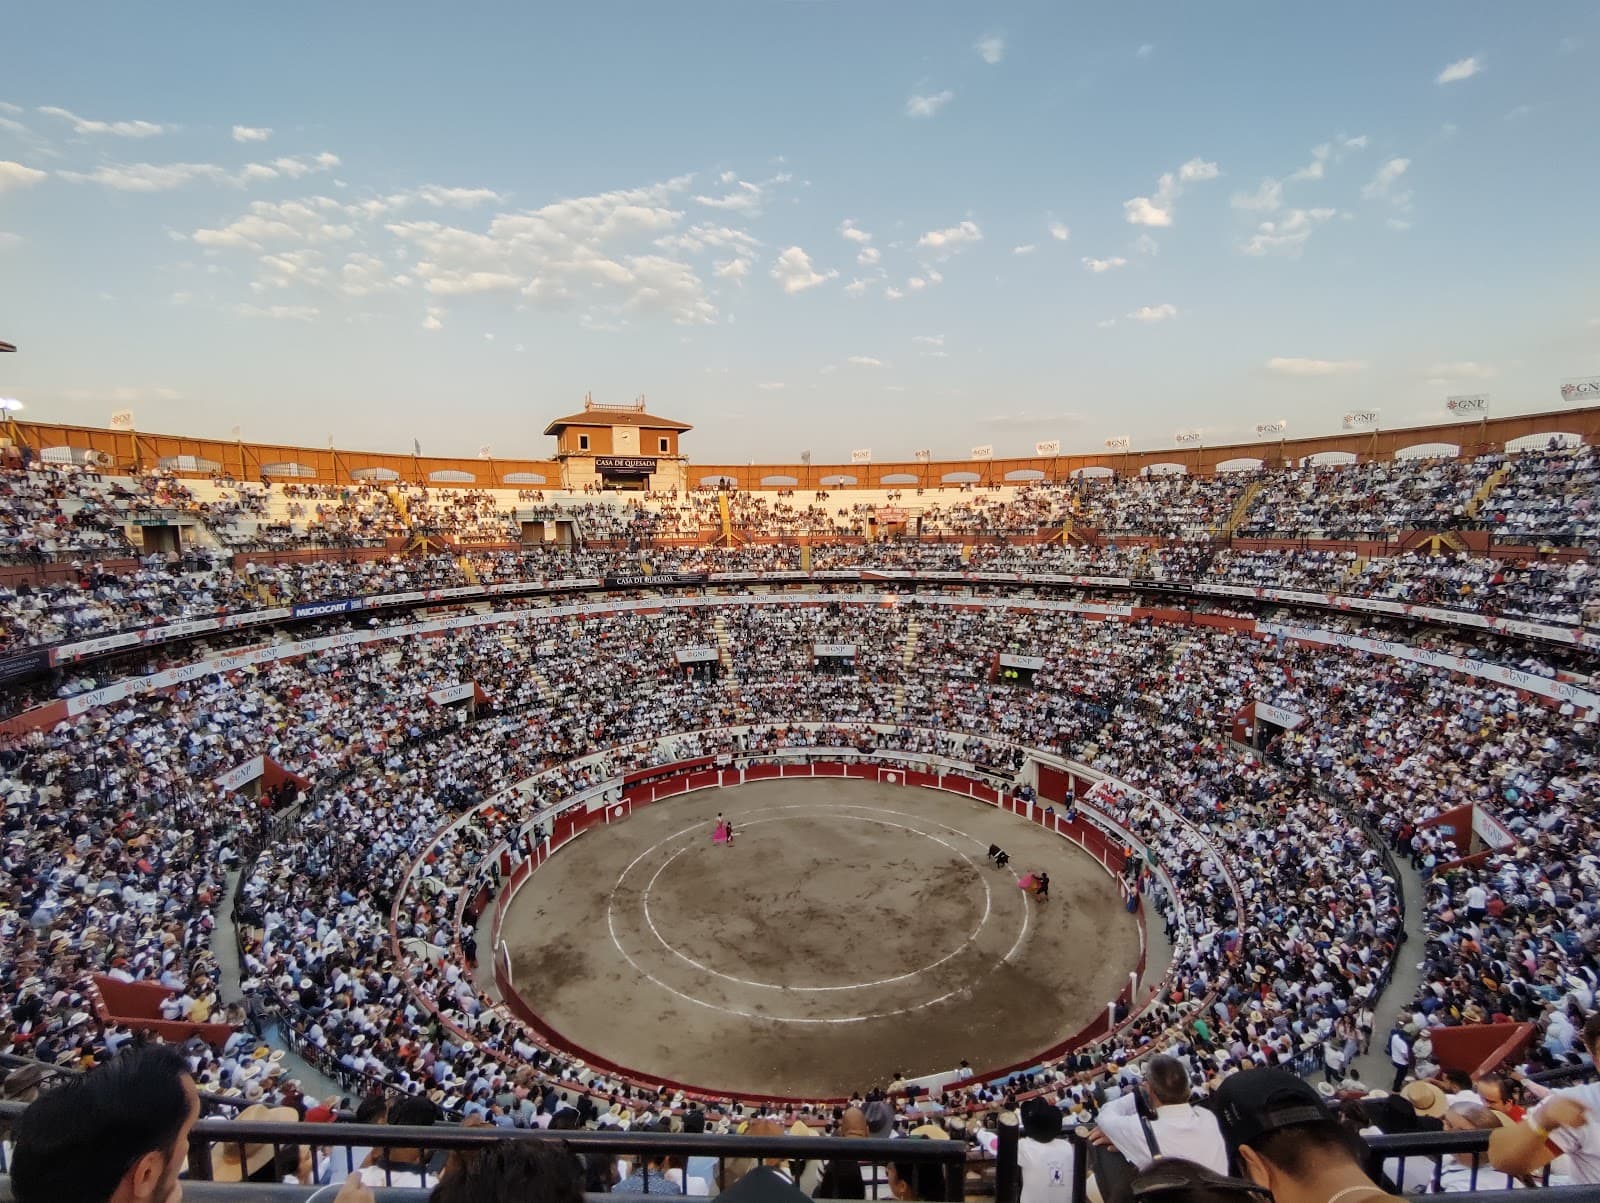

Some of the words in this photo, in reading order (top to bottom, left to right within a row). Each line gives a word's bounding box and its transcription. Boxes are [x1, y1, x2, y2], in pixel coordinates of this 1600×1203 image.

[1576, 383, 1600, 393] GN
[1458, 399, 1485, 409] GNP
[1353, 413, 1376, 422] GNP
[1263, 424, 1283, 433] GNP
[1182, 433, 1200, 441] GNP
[625, 460, 656, 468] QUESADA
[616, 577, 634, 585] CASA
[296, 602, 348, 618] MICROCART
[1296, 628, 1312, 637] GNP
[339, 635, 354, 643] GNP
[1335, 634, 1352, 643] GNP
[300, 641, 317, 649] GNP
[1377, 642, 1395, 651] GNP
[261, 649, 277, 658] GNP
[1419, 651, 1437, 661] GNP
[220, 657, 237, 667] GNP
[1464, 660, 1483, 671] GNP
[177, 667, 195, 678] GNP
[1509, 671, 1530, 683] GNP
[447, 687, 463, 697] GNP
[1558, 685, 1579, 697] GNP
[86, 692, 105, 705] GNP
[1273, 711, 1290, 722] GNP
[235, 765, 251, 781] GNP
